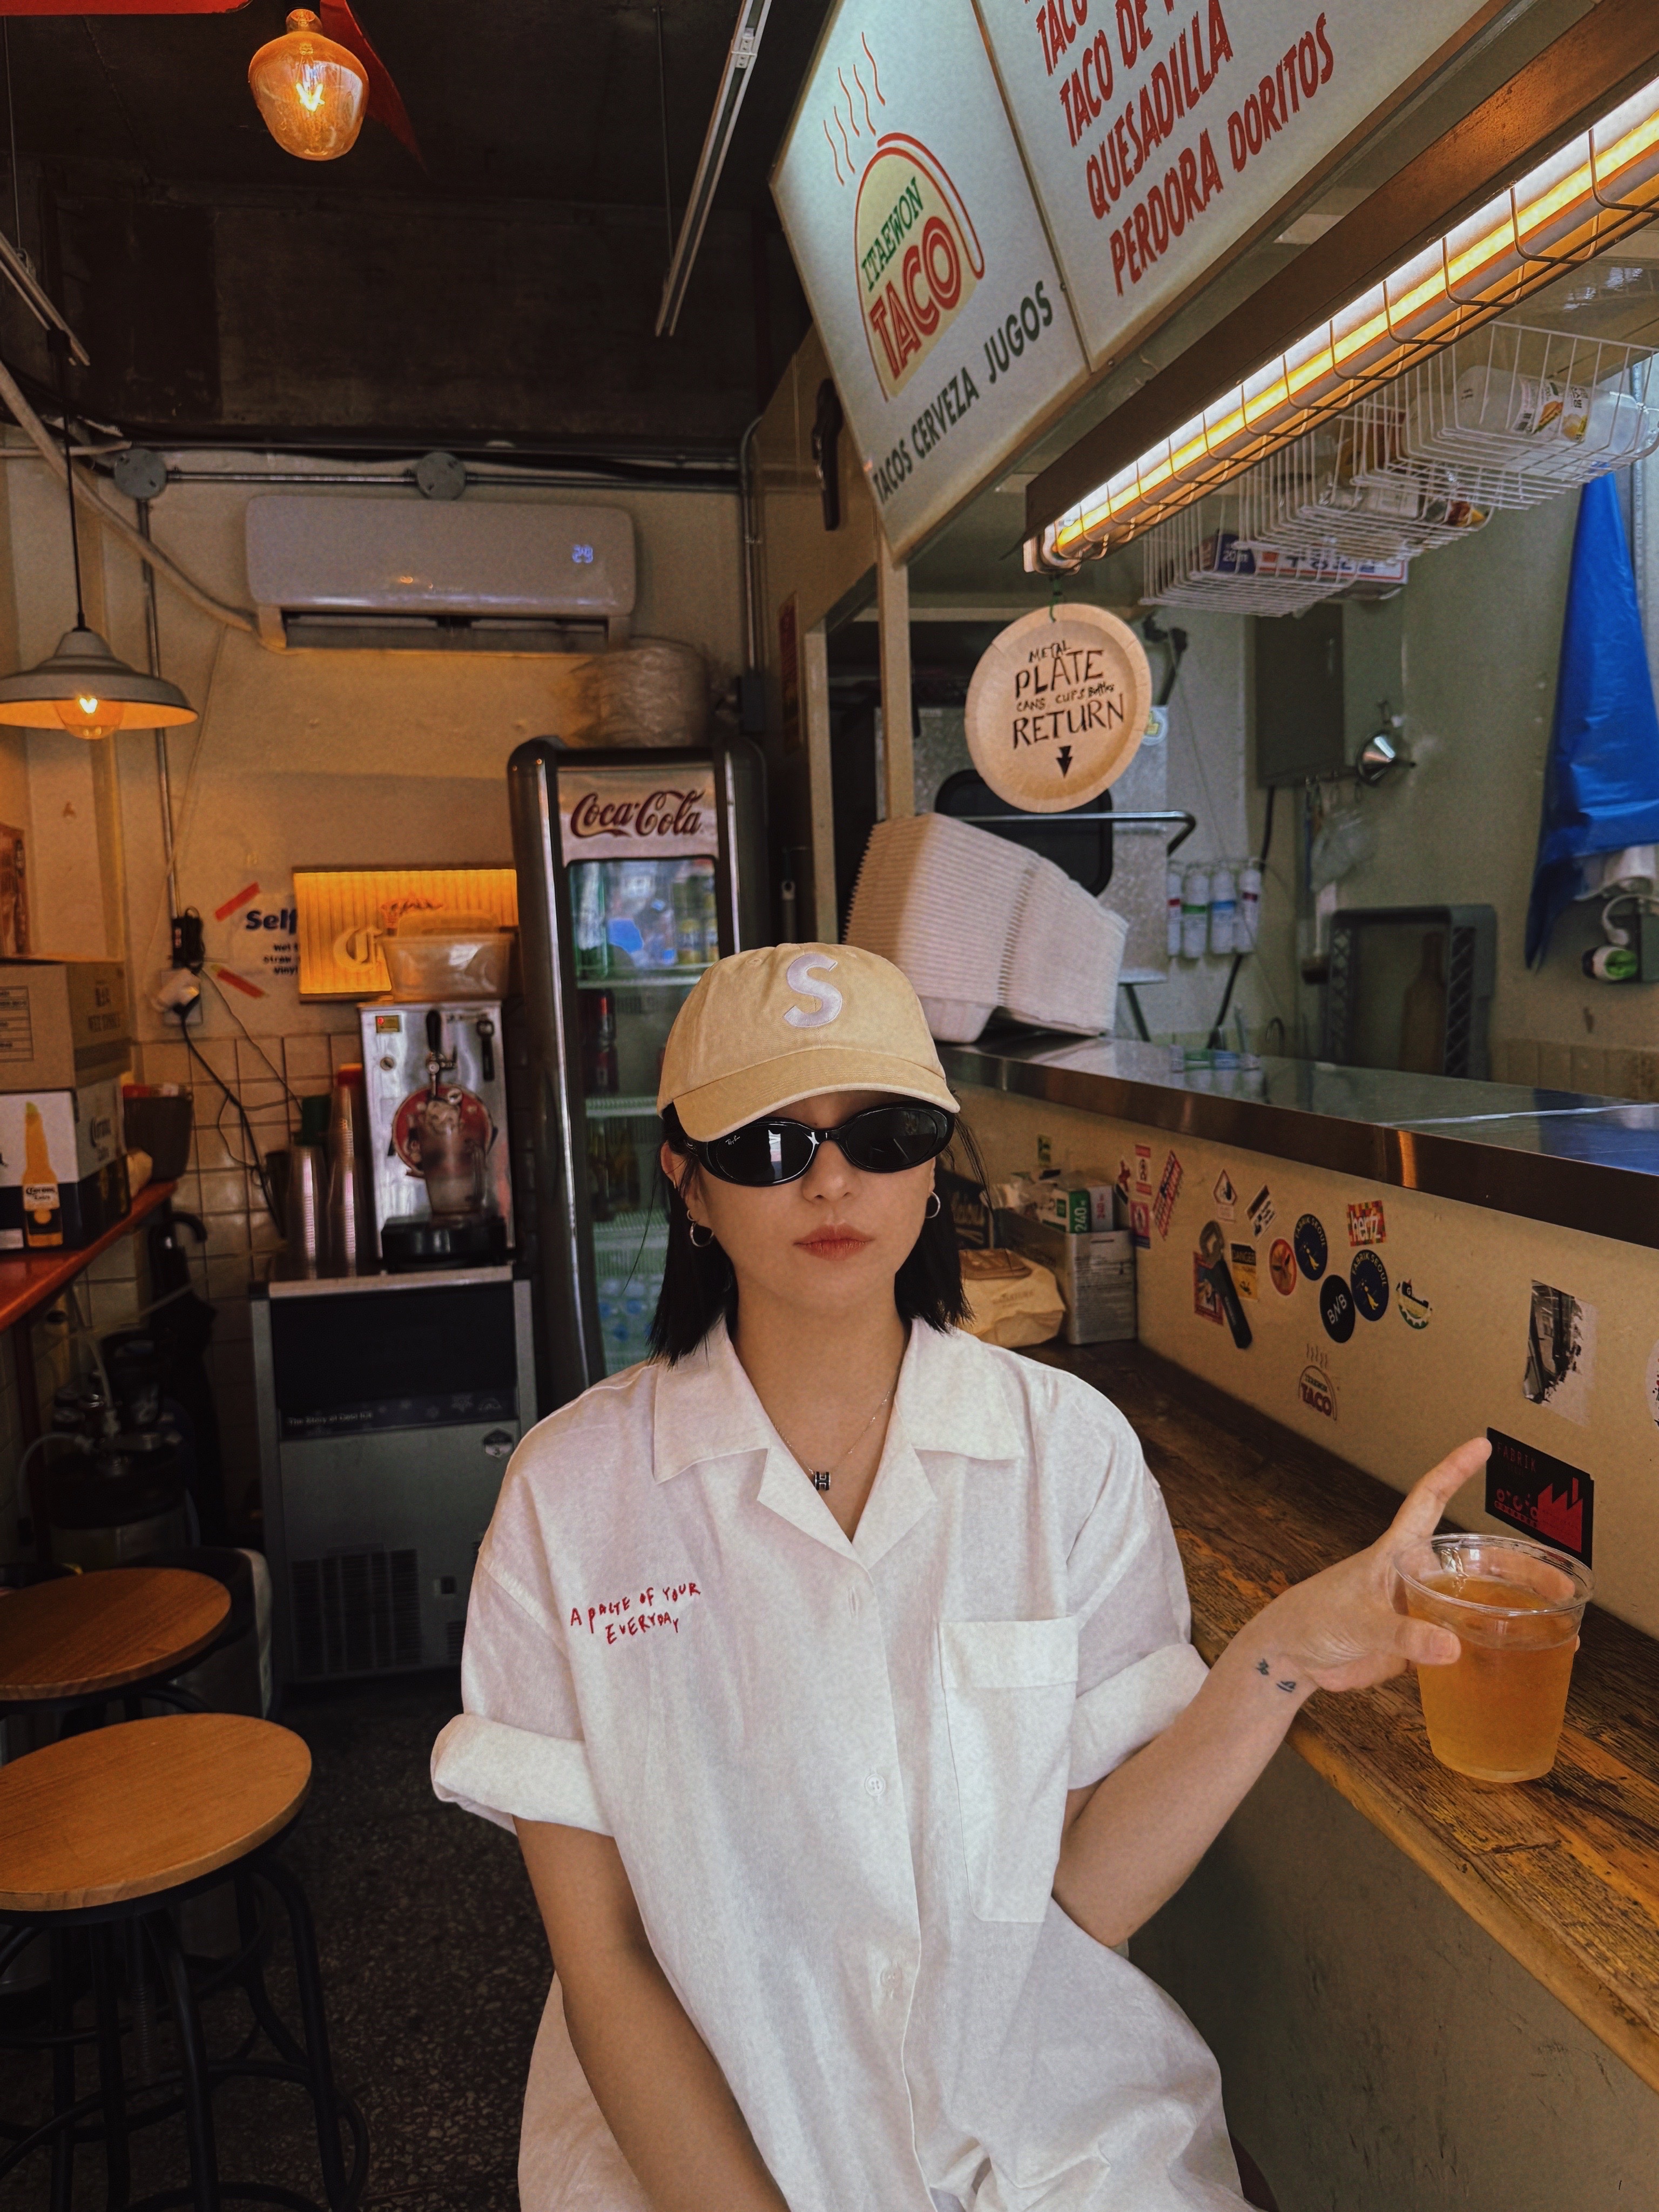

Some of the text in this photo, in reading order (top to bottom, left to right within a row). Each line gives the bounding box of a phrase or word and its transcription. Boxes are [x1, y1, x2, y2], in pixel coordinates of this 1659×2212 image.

[1060, 0, 1152, 147] TACO DE
[1086, 0, 1233, 219] QUESADILLA
[1110, 12, 1333, 296] PERDORA DORITOS
[861, 177, 923, 292] ITAEWON
[869, 217, 961, 380] TACO
[872, 280, 1053, 504] TACOS CERVEZA JUGOS
[1015, 649, 1104, 699] PLATE
[1029, 640, 1070, 663] METAL
[1013, 692, 1124, 750] RETURN
[1016, 697, 1046, 712] CANS
[1055, 689, 1084, 704] CUPS
[571, 790, 705, 838] Coca-Cola
[246, 908, 297, 935] Self
[784, 953, 842, 1028] S
[1352, 1252, 1387, 1287] FABRIK SEOUL
[570, 1607, 582, 1626] A
[639, 1587, 653, 1606] OF
[663, 1582, 701, 1602] YOUR
[605, 1611, 679, 1644] EVERYDAY
